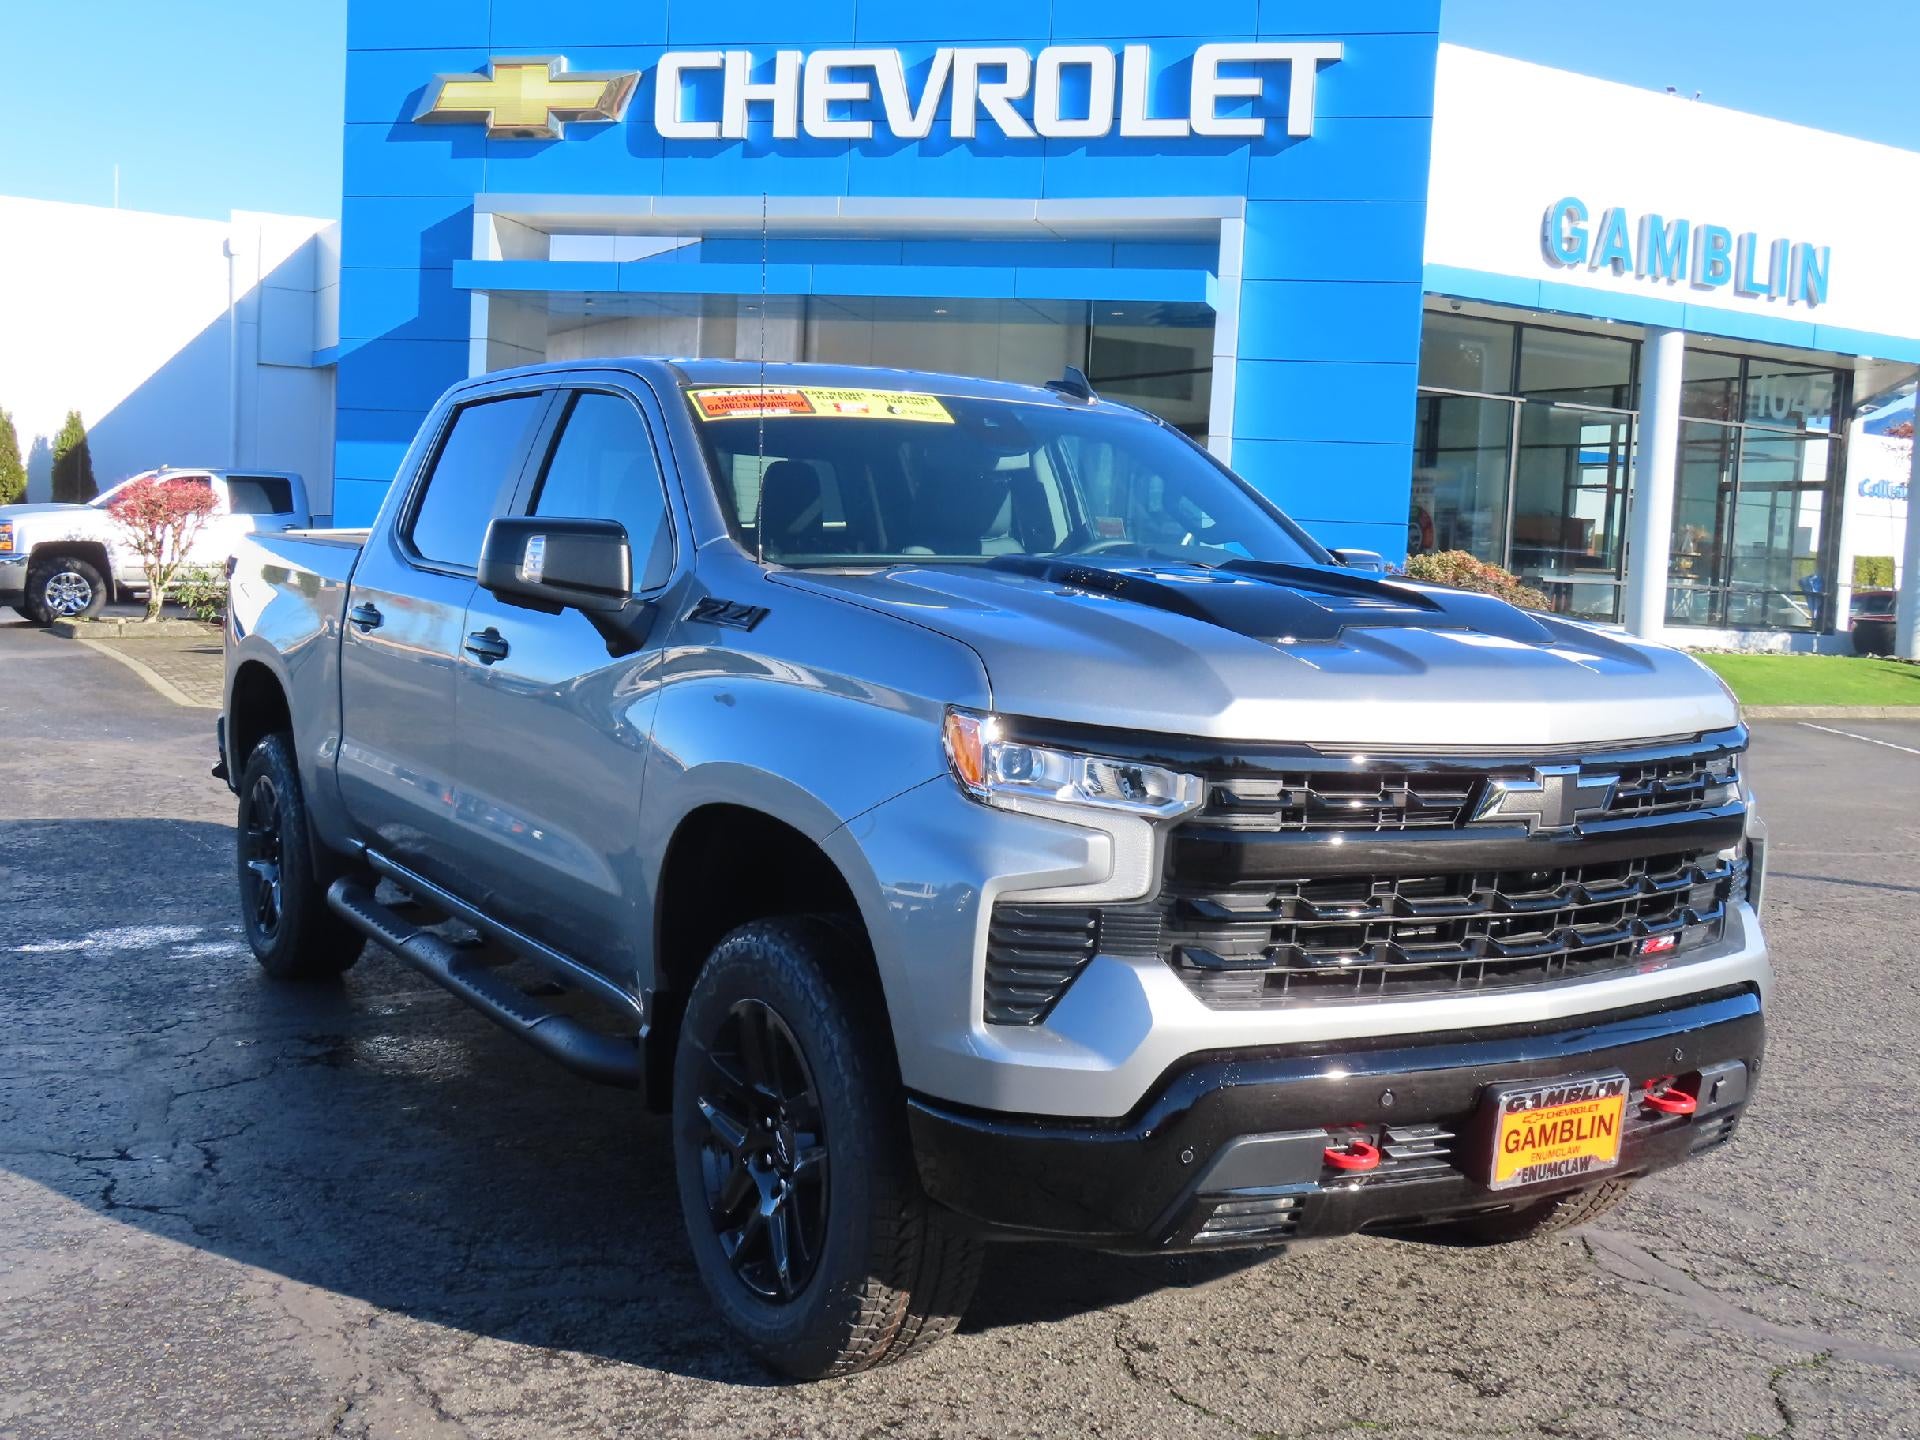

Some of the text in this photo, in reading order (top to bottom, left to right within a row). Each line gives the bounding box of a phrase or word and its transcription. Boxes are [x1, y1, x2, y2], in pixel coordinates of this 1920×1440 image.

[654, 42, 1344, 139] CHEVROLET
[1543, 196, 1831, 306] GAMBLIN
[707, 400, 807, 411] GAMBLIN ADVANTAGE
[718, 393, 789, 403] SAVE WITH THE
[1505, 1080, 1624, 1113] GAMBLIN
[1546, 1103, 1600, 1120] CHEVROLET
[1505, 1113, 1614, 1154] GAMBLIN
[1531, 1145, 1581, 1161] ENUMCLAW
[1521, 1154, 1592, 1183] ENUMCLAW
